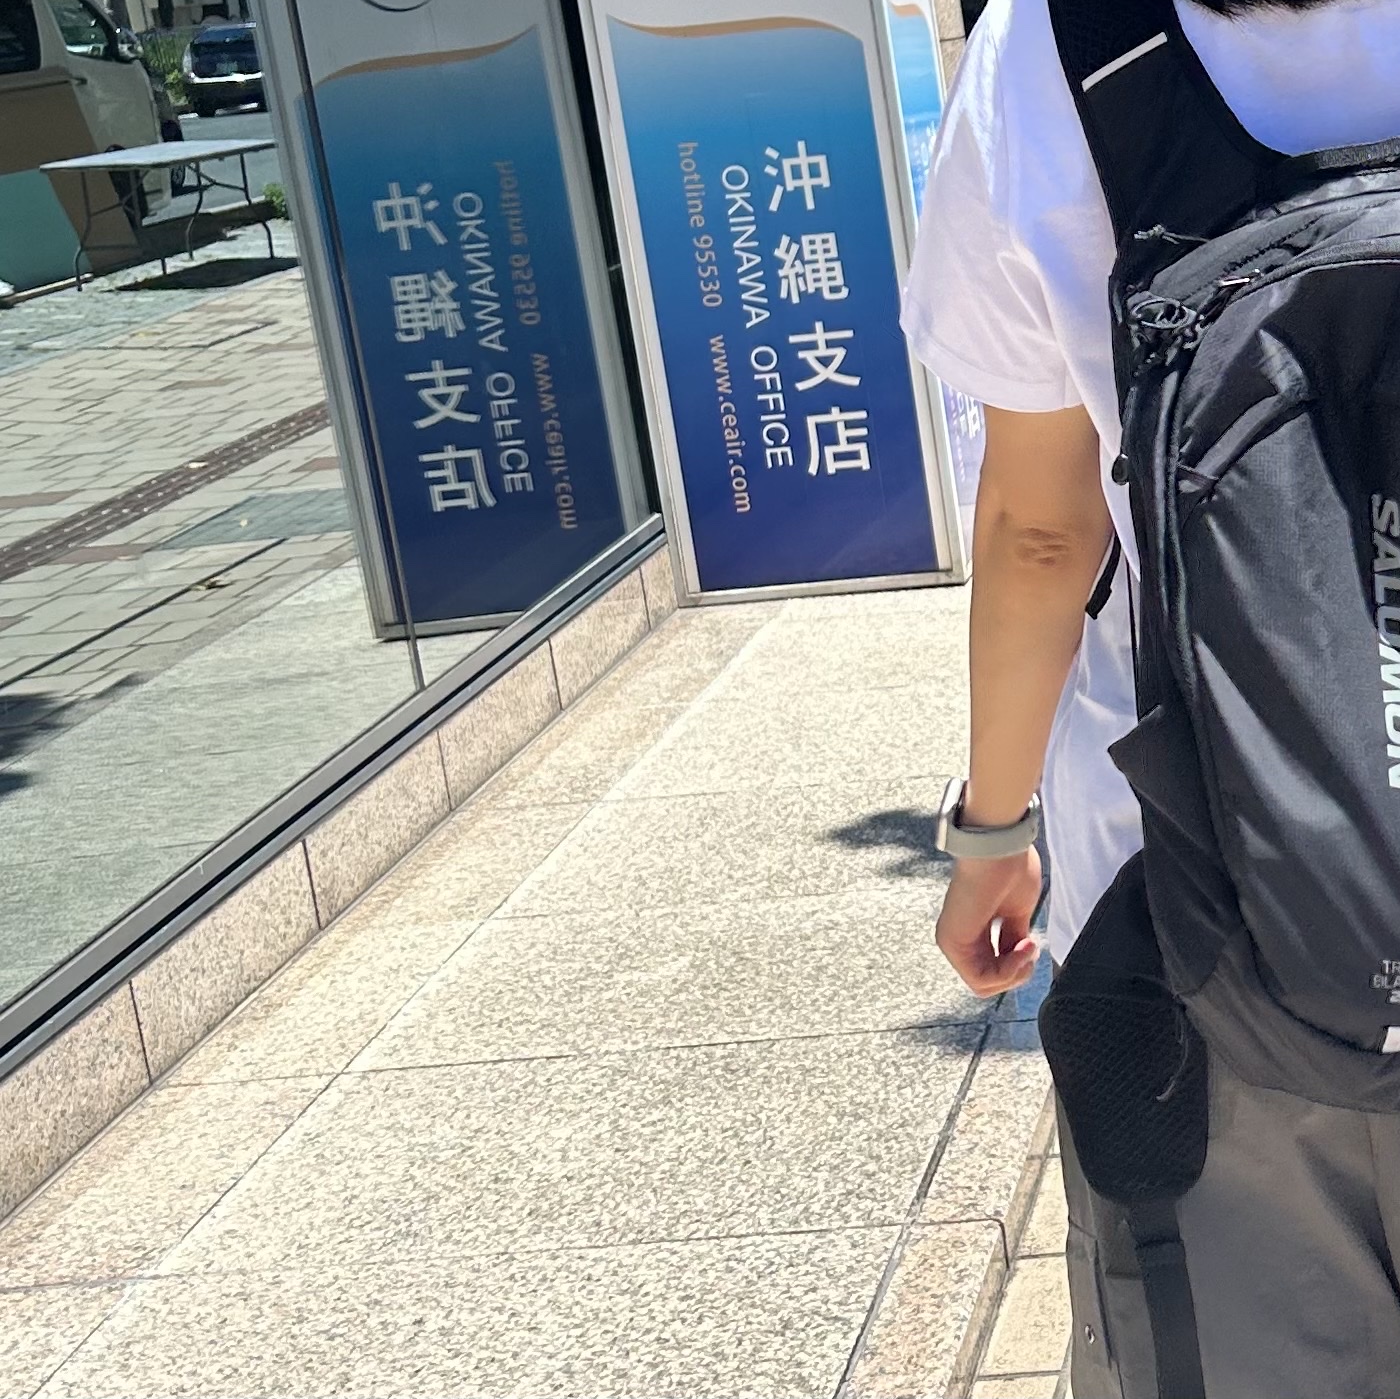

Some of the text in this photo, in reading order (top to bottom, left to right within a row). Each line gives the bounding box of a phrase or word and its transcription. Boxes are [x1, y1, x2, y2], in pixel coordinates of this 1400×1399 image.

[677, 141, 751, 514] hotline 95530 www.ceair.com
[721, 164, 796, 469] OKINAWA OFFICE
[763, 139, 871, 477] 沖縄支店
